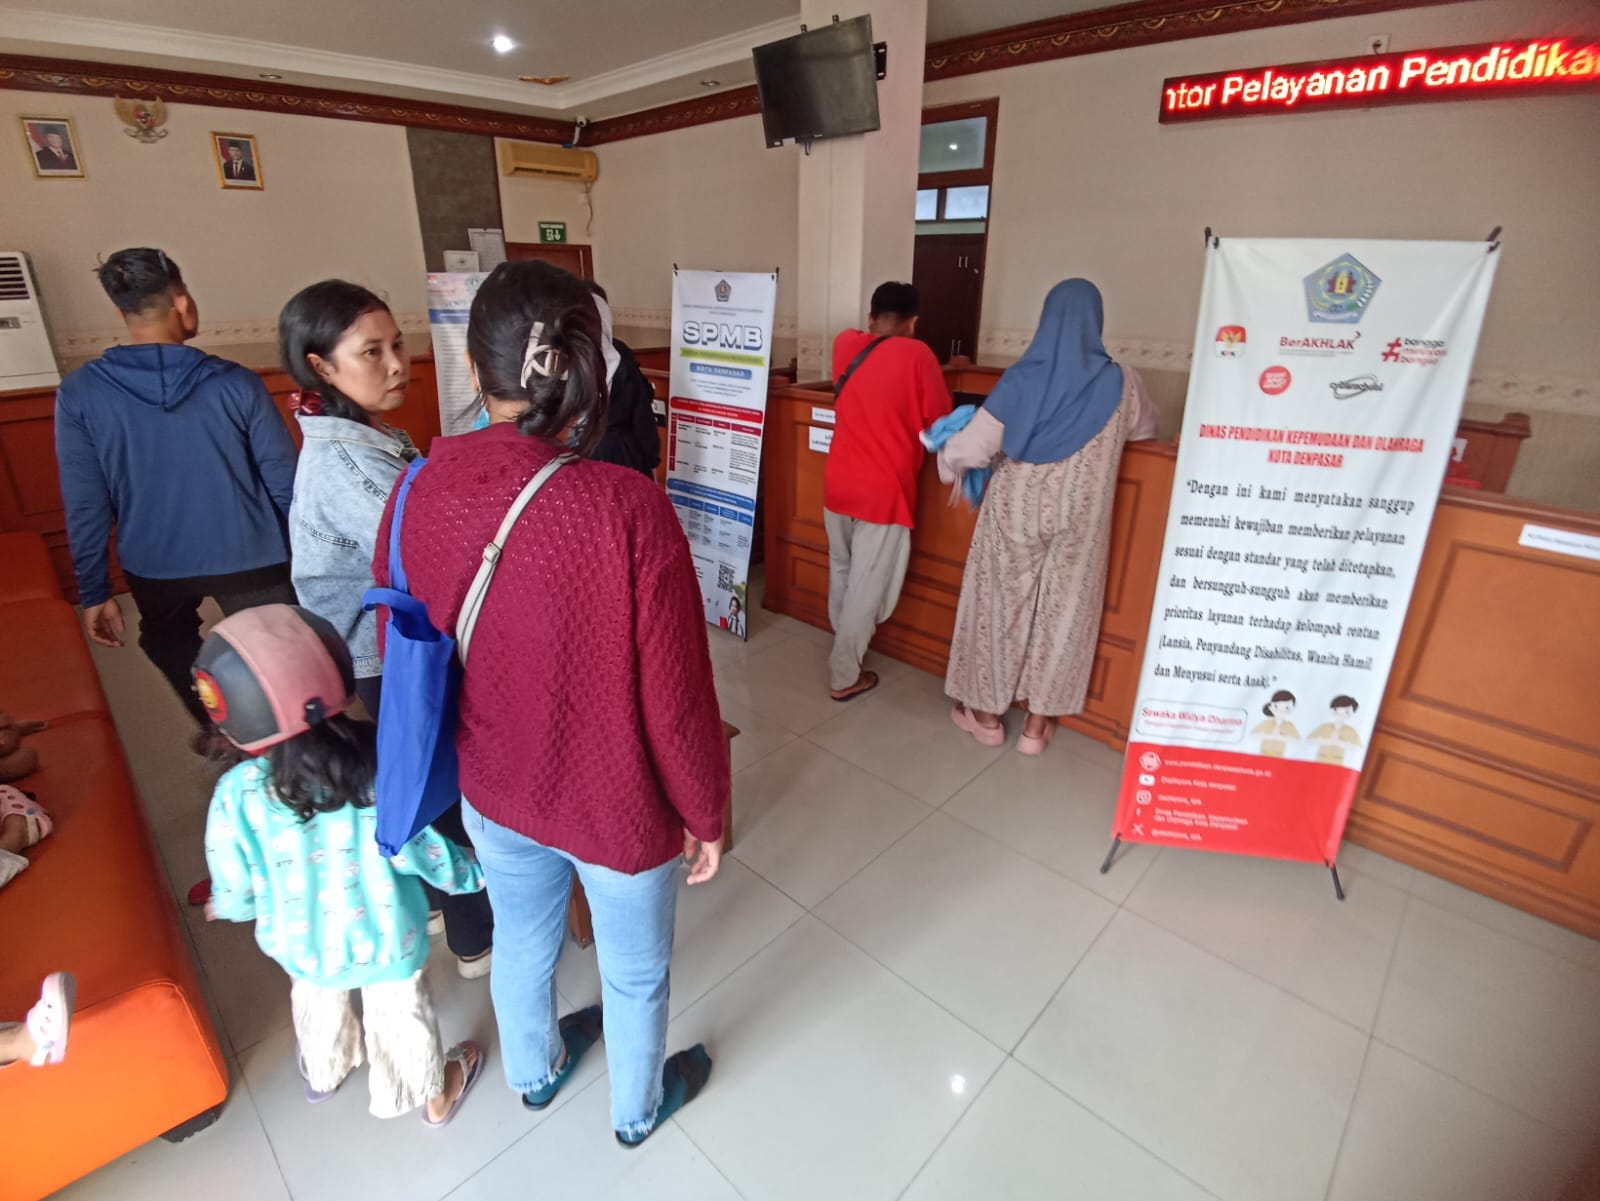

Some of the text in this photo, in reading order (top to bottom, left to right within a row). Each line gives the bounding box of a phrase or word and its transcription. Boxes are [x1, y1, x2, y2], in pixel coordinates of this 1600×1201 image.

[1222, 66, 1390, 104] Pelayanan
[682, 320, 762, 351] SPMB
[1200, 424, 1227, 439] DINAS
[1230, 426, 1283, 443] PENDIDIKAN
[1352, 434, 1372, 449] DAN
[1268, 449, 1343, 468] KOTA DENPASAR
[1236, 483, 1252, 498] ini
[1259, 485, 1287, 501] kami
[1294, 492, 1362, 508] menyatakan
[1368, 497, 1414, 515] sanggup
[1181, 515, 1405, 545] memenuhi kewajiban memberikan pelayanan
[1175, 545, 1204, 558] sesuai
[1206, 546, 1240, 564] dengan
[1243, 551, 1281, 566] standar
[1283, 557, 1308, 573] yang
[1312, 558, 1335, 572] telah
[1170, 574, 1388, 609] dan bersungguh-sungguh akan memberikan
[1164, 605, 1380, 640] prioritas layanan terhadap kelompok rentan
[1196, 637, 1251, 660] Penyandang
[1307, 650, 1340, 666] Wanita
[1154, 664, 1170, 677] dan
[1173, 665, 1216, 683] Menyusui
[1218, 673, 1241, 685] serta
